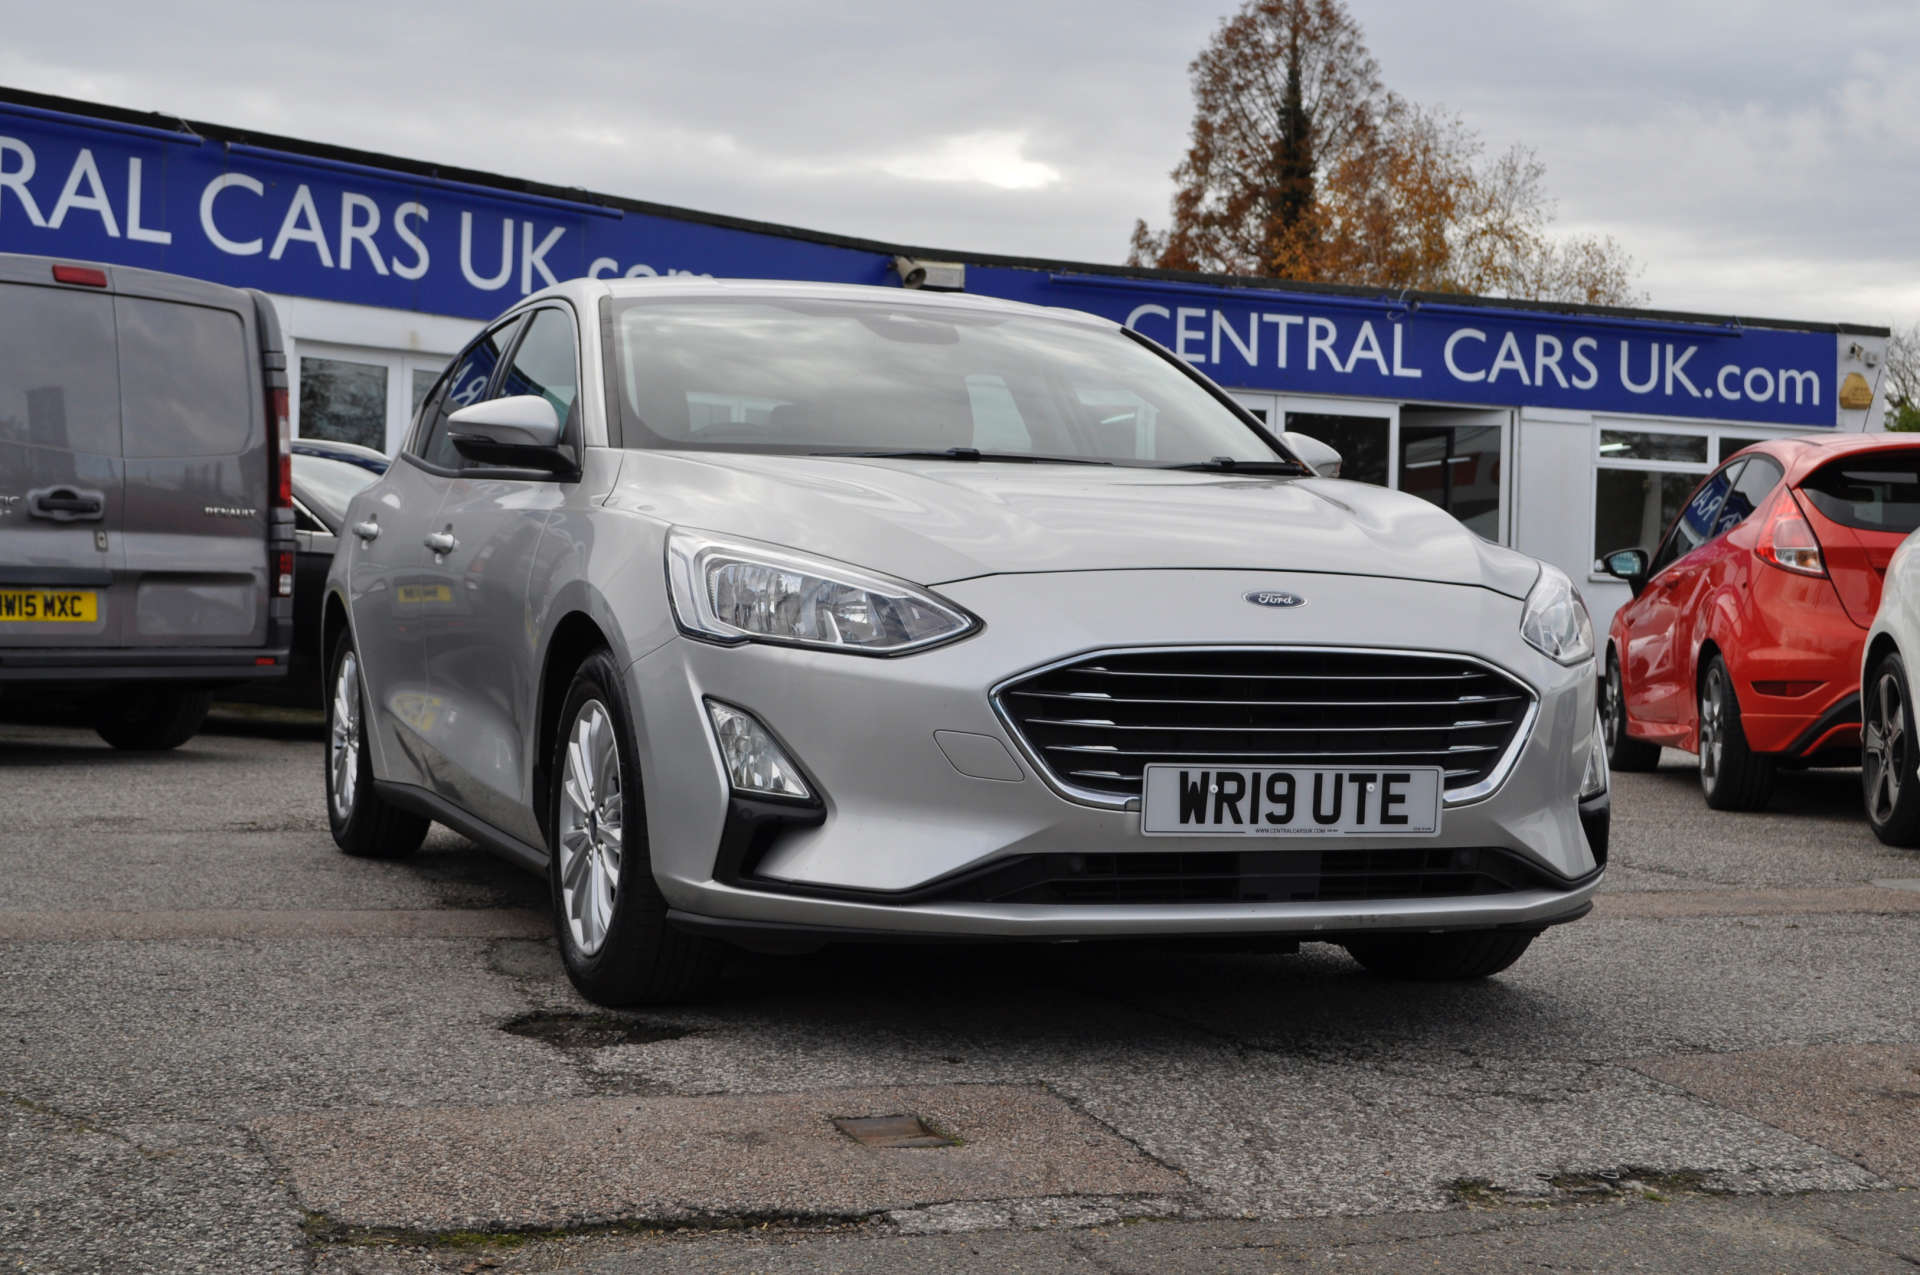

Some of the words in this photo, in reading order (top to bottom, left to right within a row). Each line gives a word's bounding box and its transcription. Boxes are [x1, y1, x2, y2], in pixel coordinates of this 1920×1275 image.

[0, 135, 172, 245] RAL
[199, 172, 430, 280] CARS
[1124, 303, 1422, 378] CENTRAL
[1443, 328, 1598, 390] CARS
[1620, 340, 1820, 406] UK.com
[43, 594, 82, 617] MXC
[1258, 593, 1294, 604] Ford
[1179, 771, 1296, 825] WR19
[1312, 772, 1411, 825] UTE
